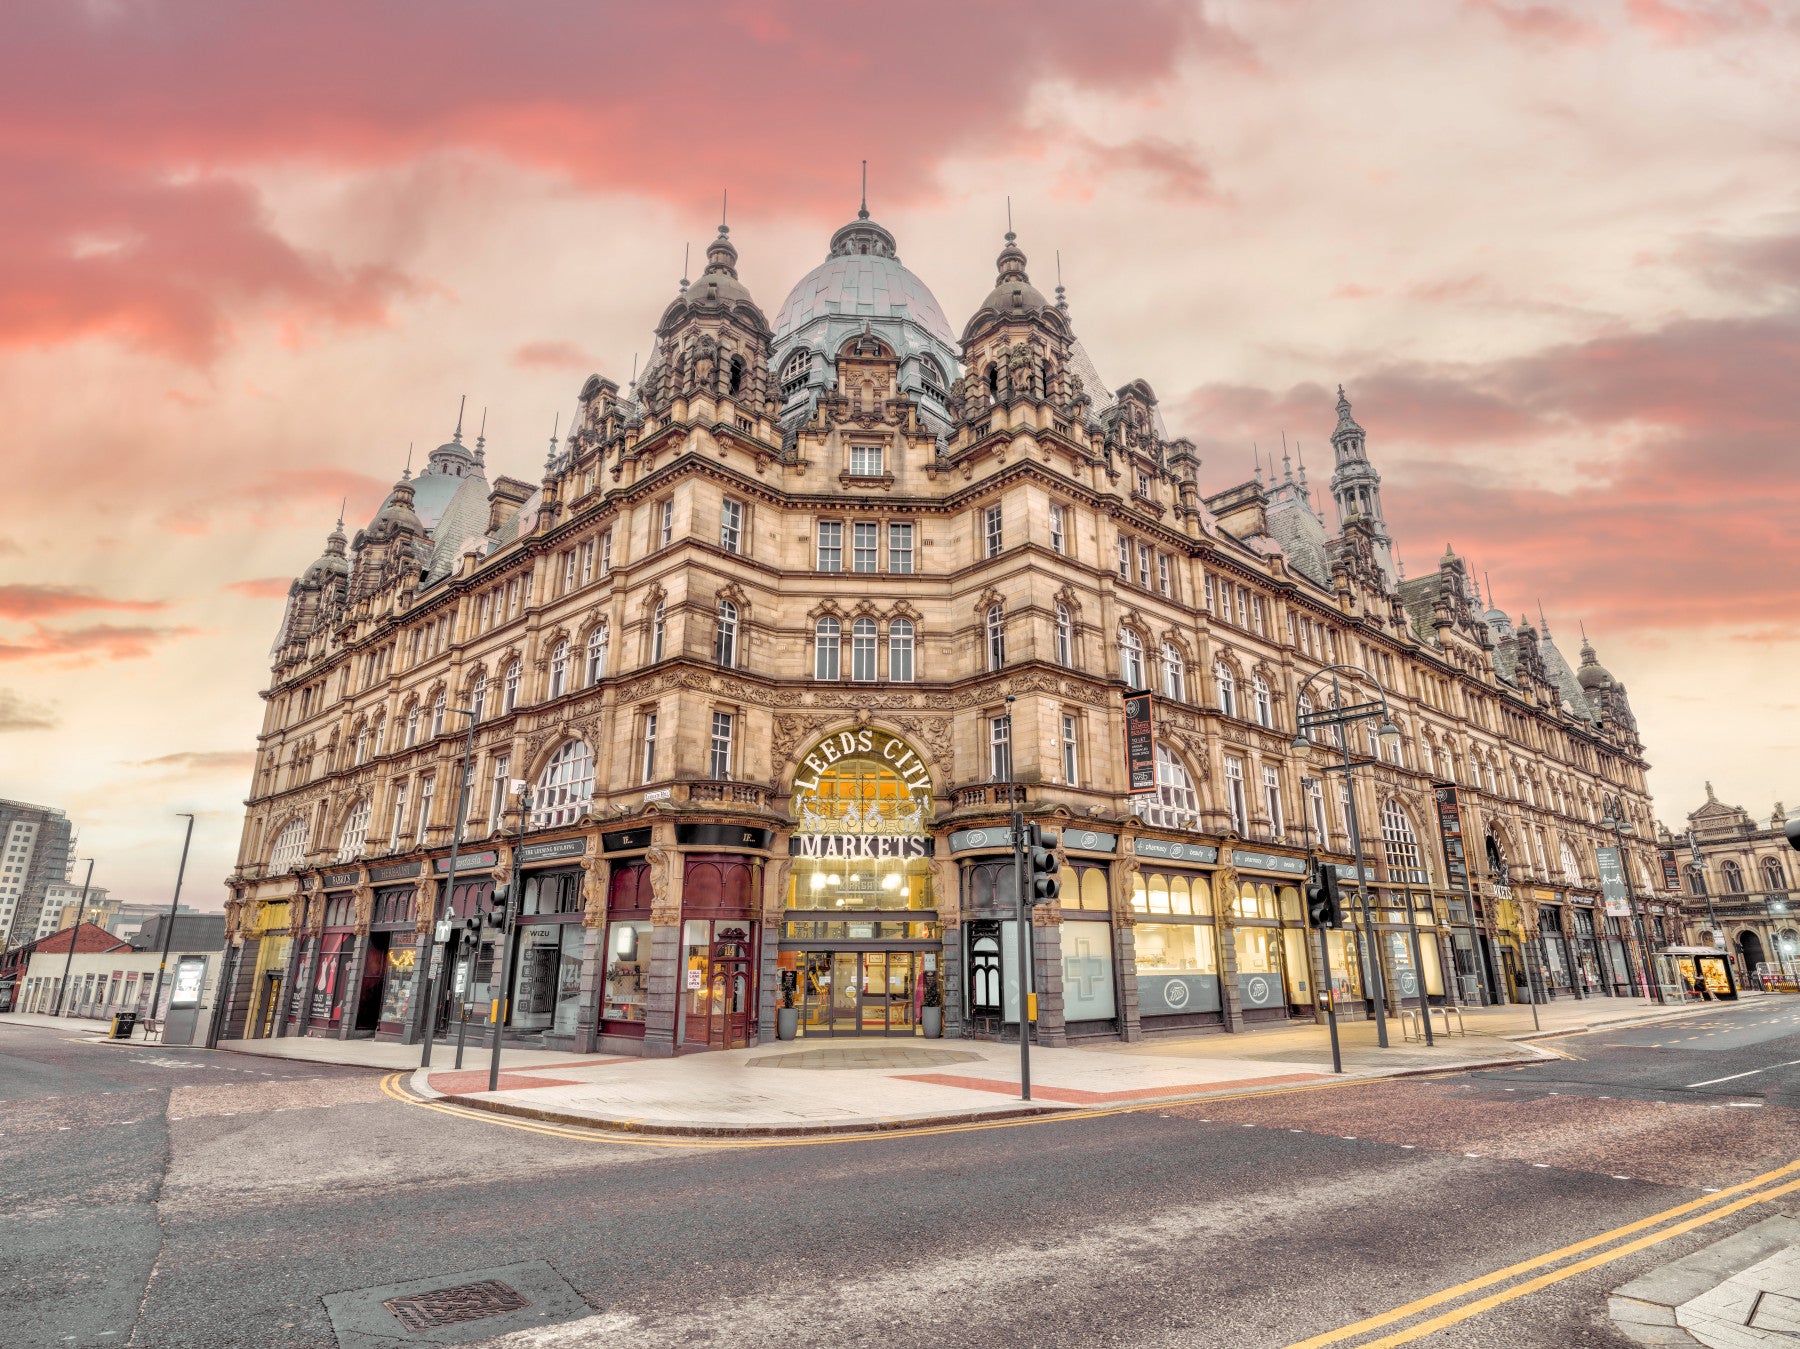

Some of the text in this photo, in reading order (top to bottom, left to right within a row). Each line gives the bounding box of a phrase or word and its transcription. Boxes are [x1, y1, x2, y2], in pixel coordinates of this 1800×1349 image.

[795, 730, 932, 791] LEEDS CITY
[799, 834, 925, 858] MARKETS
[1145, 843, 1167, 853] pharmacy
